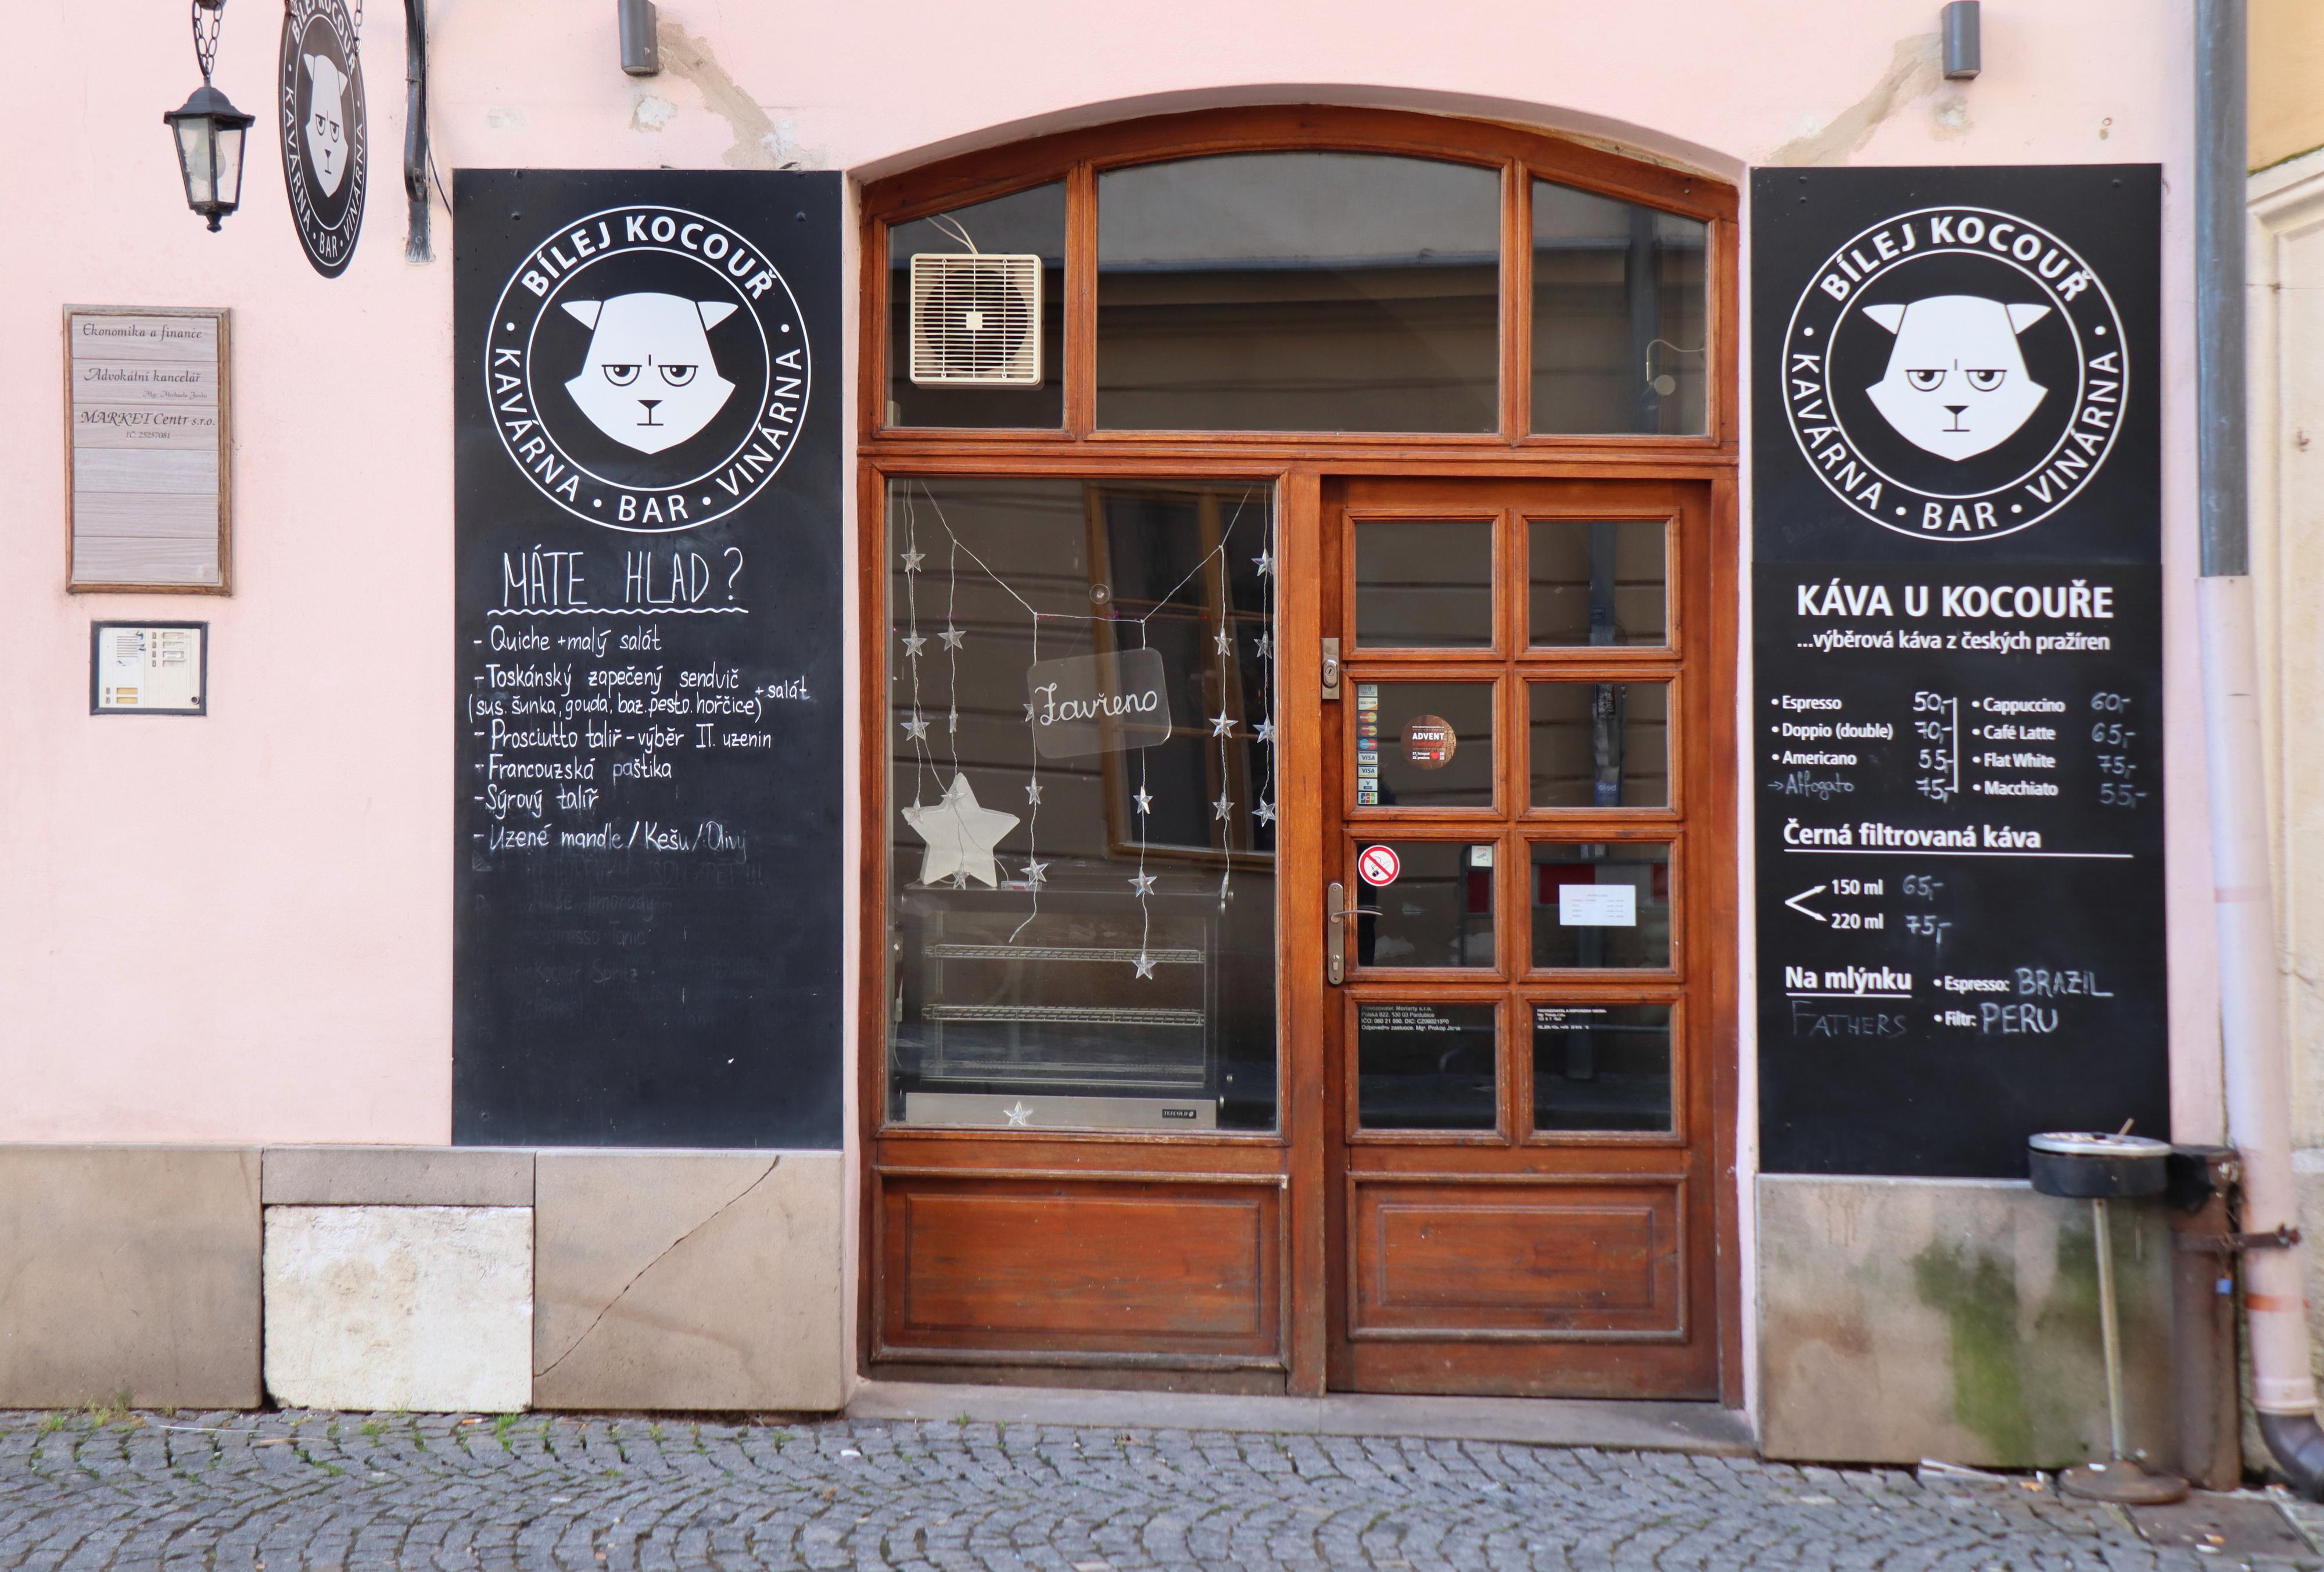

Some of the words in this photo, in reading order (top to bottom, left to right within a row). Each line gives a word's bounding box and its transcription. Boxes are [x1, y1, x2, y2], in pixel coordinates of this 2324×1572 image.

[285, 85, 311, 232] KAVÁRNA
[344, 123, 363, 241] VINÁRNA
[320, 231, 338, 258] BAR
[521, 221, 612, 298] BÍLEJ
[625, 214, 777, 300] KOCOUŘ
[1820, 223, 1916, 302] BÍLEJ
[1930, 216, 2092, 302] KOCOUŘ
[83, 323, 146, 337] Ekonomika
[150, 330, 157, 338] a
[159, 324, 203, 342] finance
[84, 368, 149, 382] Advokátní
[153, 370, 202, 383] kancelář
[81, 410, 153, 427] MARKET
[153, 413, 189, 425] Centr
[494, 348, 581, 502] KAVÁRNA
[715, 348, 802, 497] VINÁRNA
[1792, 353, 1883, 510] KAVÁRNA
[2025, 351, 2119, 503] VINÁRNA
[618, 493, 689, 524] BAR
[1921, 502, 1998, 532] BAR
[503, 543, 588, 607] MÁTE
[625, 550, 709, 604] HLAD
[1797, 578, 1893, 616] KÁVA
[1905, 586, 1928, 617] U
[1942, 579, 2114, 619] KOCOUŘE
[490, 624, 550, 652] Quiche
[619, 624, 662, 651] salát
[1899, 631, 1942, 650] káva
[1946, 636, 1957, 649] z
[1961, 631, 2031, 655] českých
[2035, 632, 2111, 654] pražíren
[588, 666, 664, 699] zapečený
[679, 661, 740, 689] sendvič
[767, 675, 811, 700] salát
[1034, 682, 1157, 726] Zavřeno
[1782, 695, 1843, 712] Espresso
[1983, 697, 2066, 715] Cappuccino
[492, 718, 578, 750] Prosciutto
[723, 731, 772, 749] uzenin
[1782, 722, 1832, 741] Doppio
[1835, 722, 1893, 740] (double)
[1983, 724, 2017, 740] Café
[2019, 725, 2057, 740] Latte
[488, 753, 596, 780] Francouzská
[612, 753, 672, 786] paštika
[1782, 750, 1857, 765] Americano
[1984, 753, 2012, 768] Flat
[2012, 753, 2056, 768] White
[1785, 770, 1855, 801] Affogato
[1984, 780, 2059, 797] Macchiato
[489, 822, 552, 850] Uzené
[1783, 818, 1852, 846] Černá
[1858, 822, 1977, 848] filtrovaná
[1983, 824, 2042, 849] káva
[1831, 879, 1860, 896] 150
[1864, 879, 1883, 896] ml
[1831, 912, 1860, 929] 220
[1864, 912, 1884, 929] ml
[1785, 966, 1818, 989] Na
[1824, 966, 1912, 994] mlýnku
[1944, 976, 2010, 994] Espresso:
[2015, 967, 2114, 997] BRAZIL
[1791, 1000, 1907, 1039] FATHERS
[1944, 1010, 1977, 1027] Filtr:
[1980, 1002, 2059, 1034] PERU
